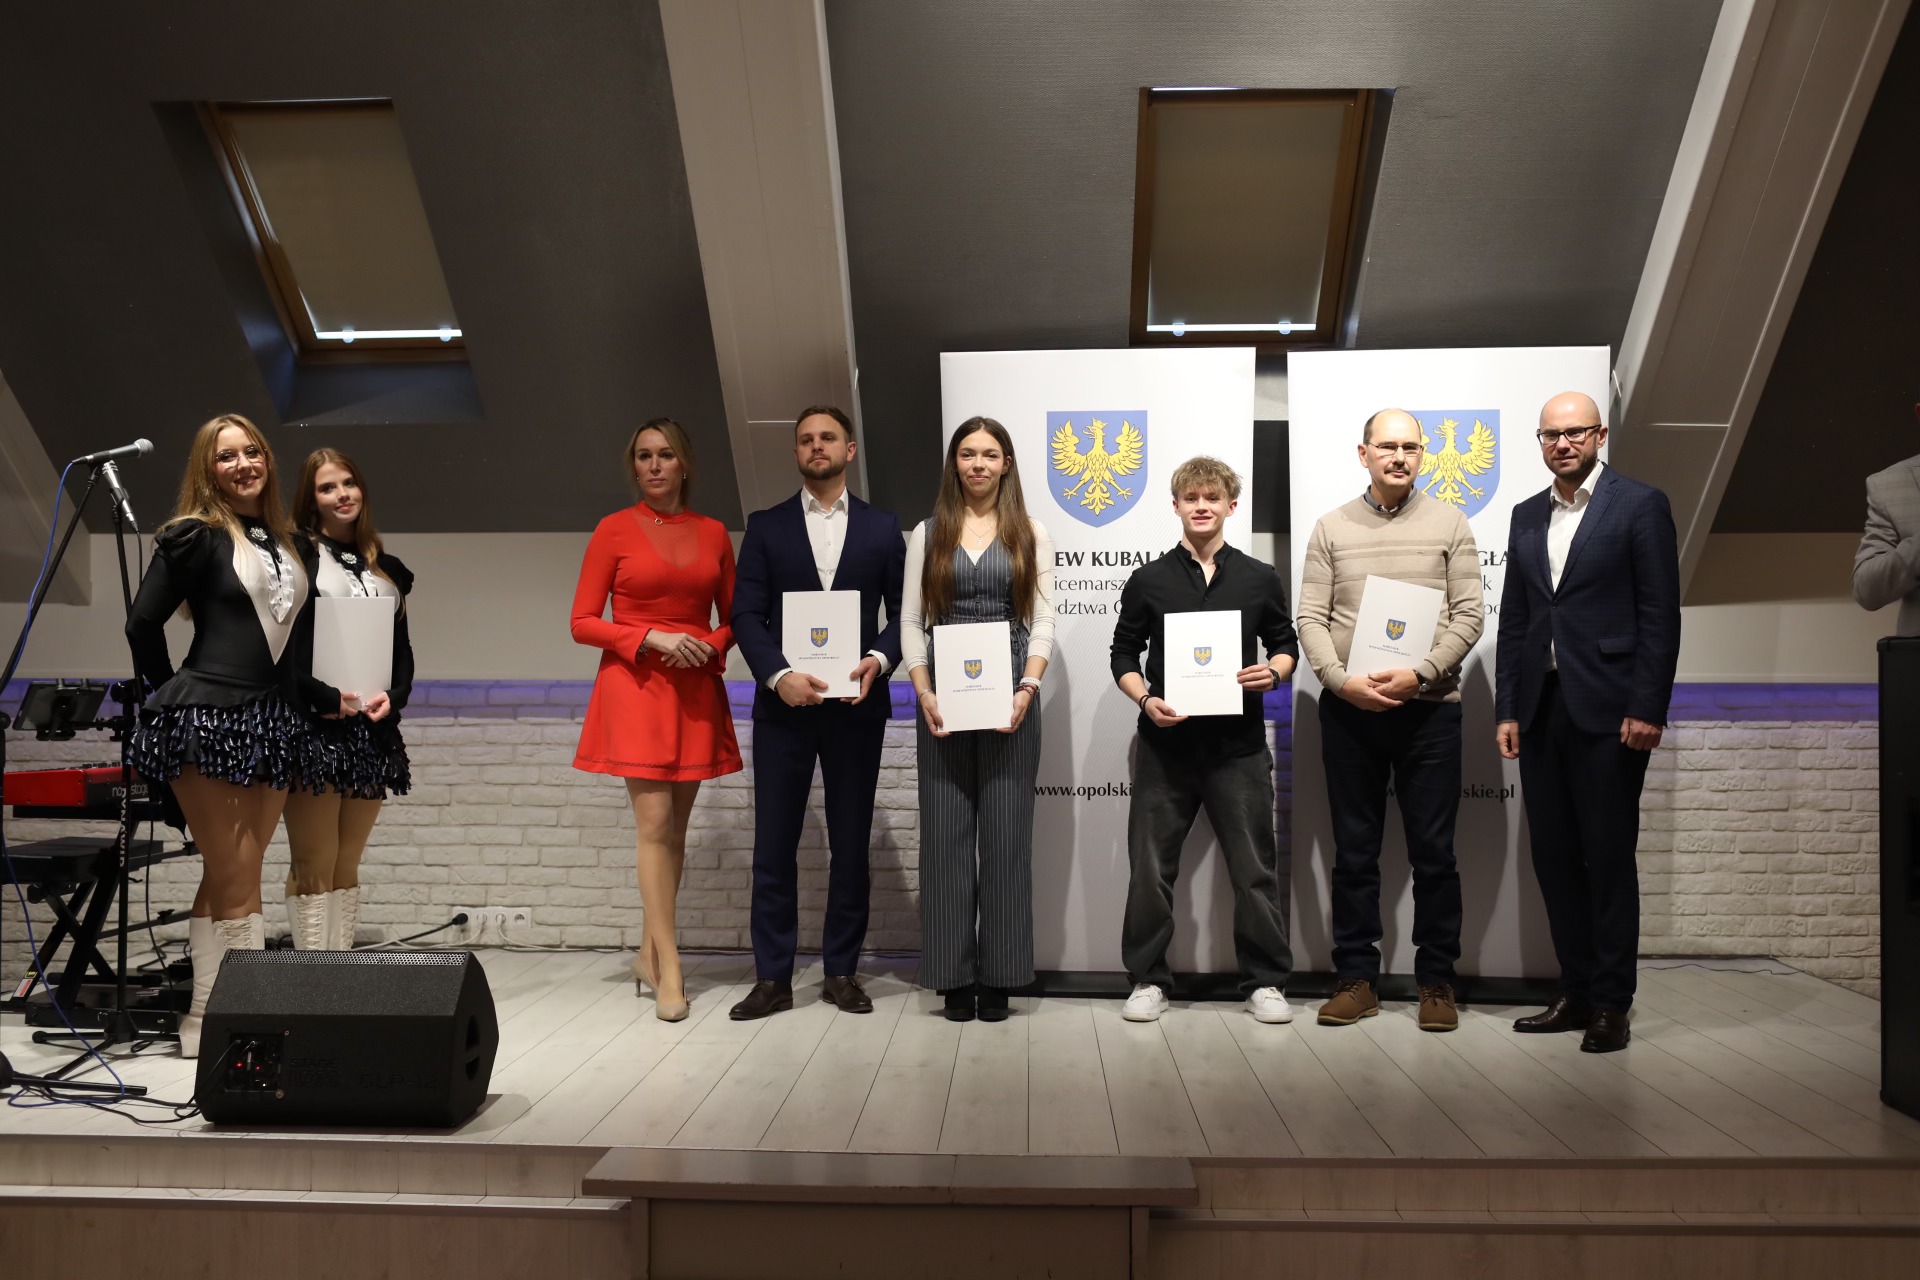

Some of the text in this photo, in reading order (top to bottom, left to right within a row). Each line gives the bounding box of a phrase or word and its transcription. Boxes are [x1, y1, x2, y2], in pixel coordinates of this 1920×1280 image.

[1054, 551, 1085, 567] EW
[1477, 550, 1508, 566] GŁA
[1054, 575, 1127, 591] icemarsz
[1056, 598, 1108, 615] dztwa
[1034, 782, 1133, 801] www.opolski
[1461, 783, 1515, 803] skie.pl
